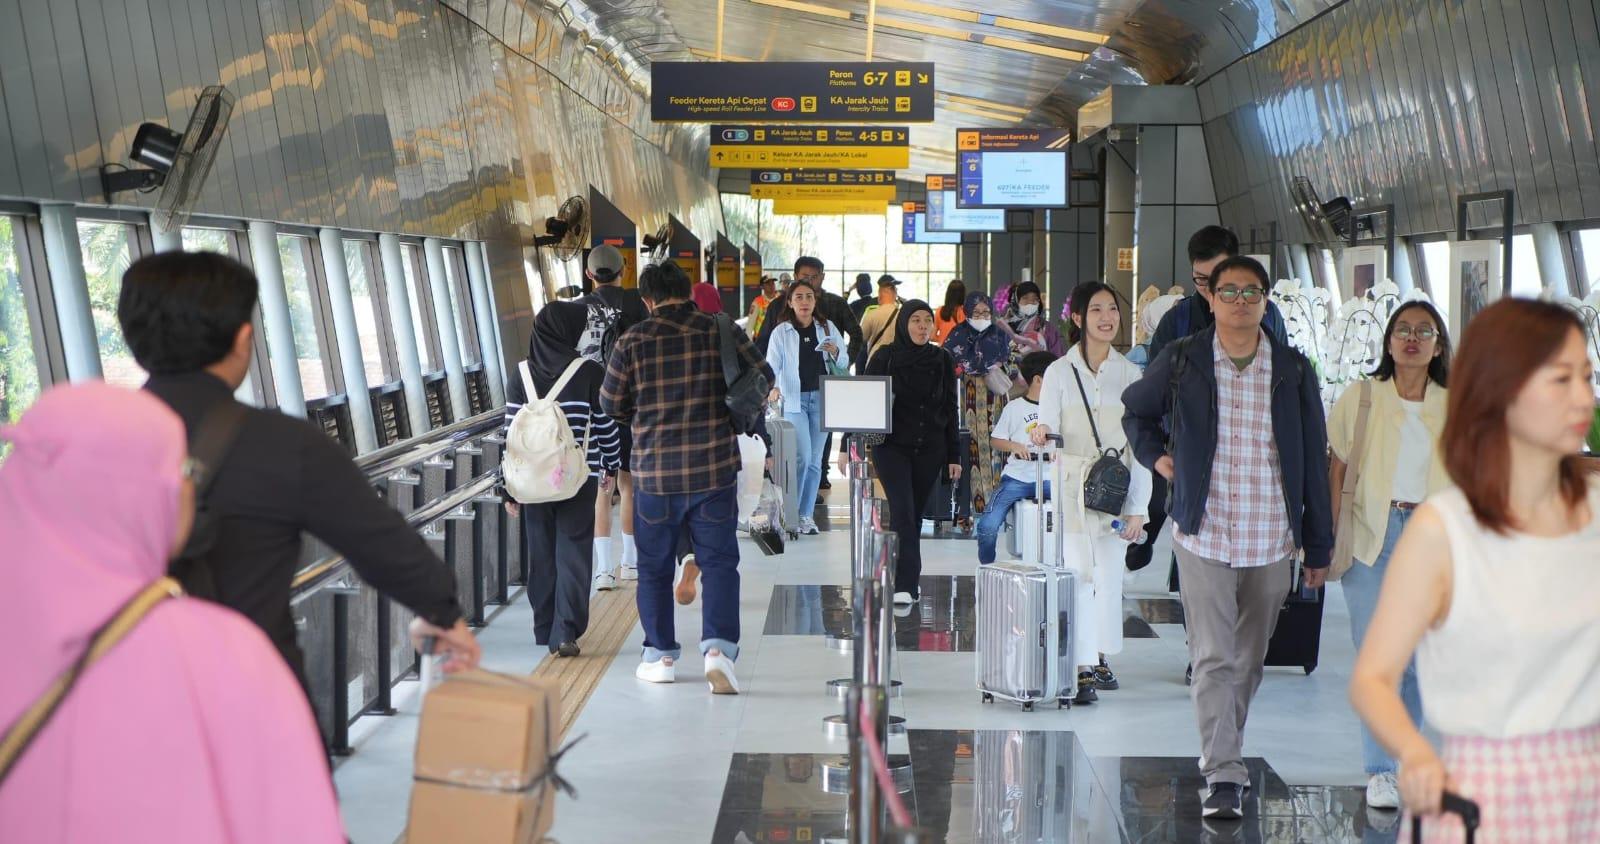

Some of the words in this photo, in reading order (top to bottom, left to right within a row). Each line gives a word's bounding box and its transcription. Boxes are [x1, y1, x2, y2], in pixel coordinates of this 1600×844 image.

[829, 70, 853, 78] Peron
[669, 96, 697, 105] Feeder
[698, 96, 725, 105] Kereta
[726, 96, 741, 106] Api
[742, 96, 767, 106] Cepat
[830, 96, 843, 105] KA
[844, 96, 868, 105] Jarak
[868, 96, 889, 105] Jauh
[688, 105, 720, 113] High-speed
[969, 163, 976, 172] 6
[969, 189, 976, 198] 7
[1024, 413, 1038, 423] LEG
